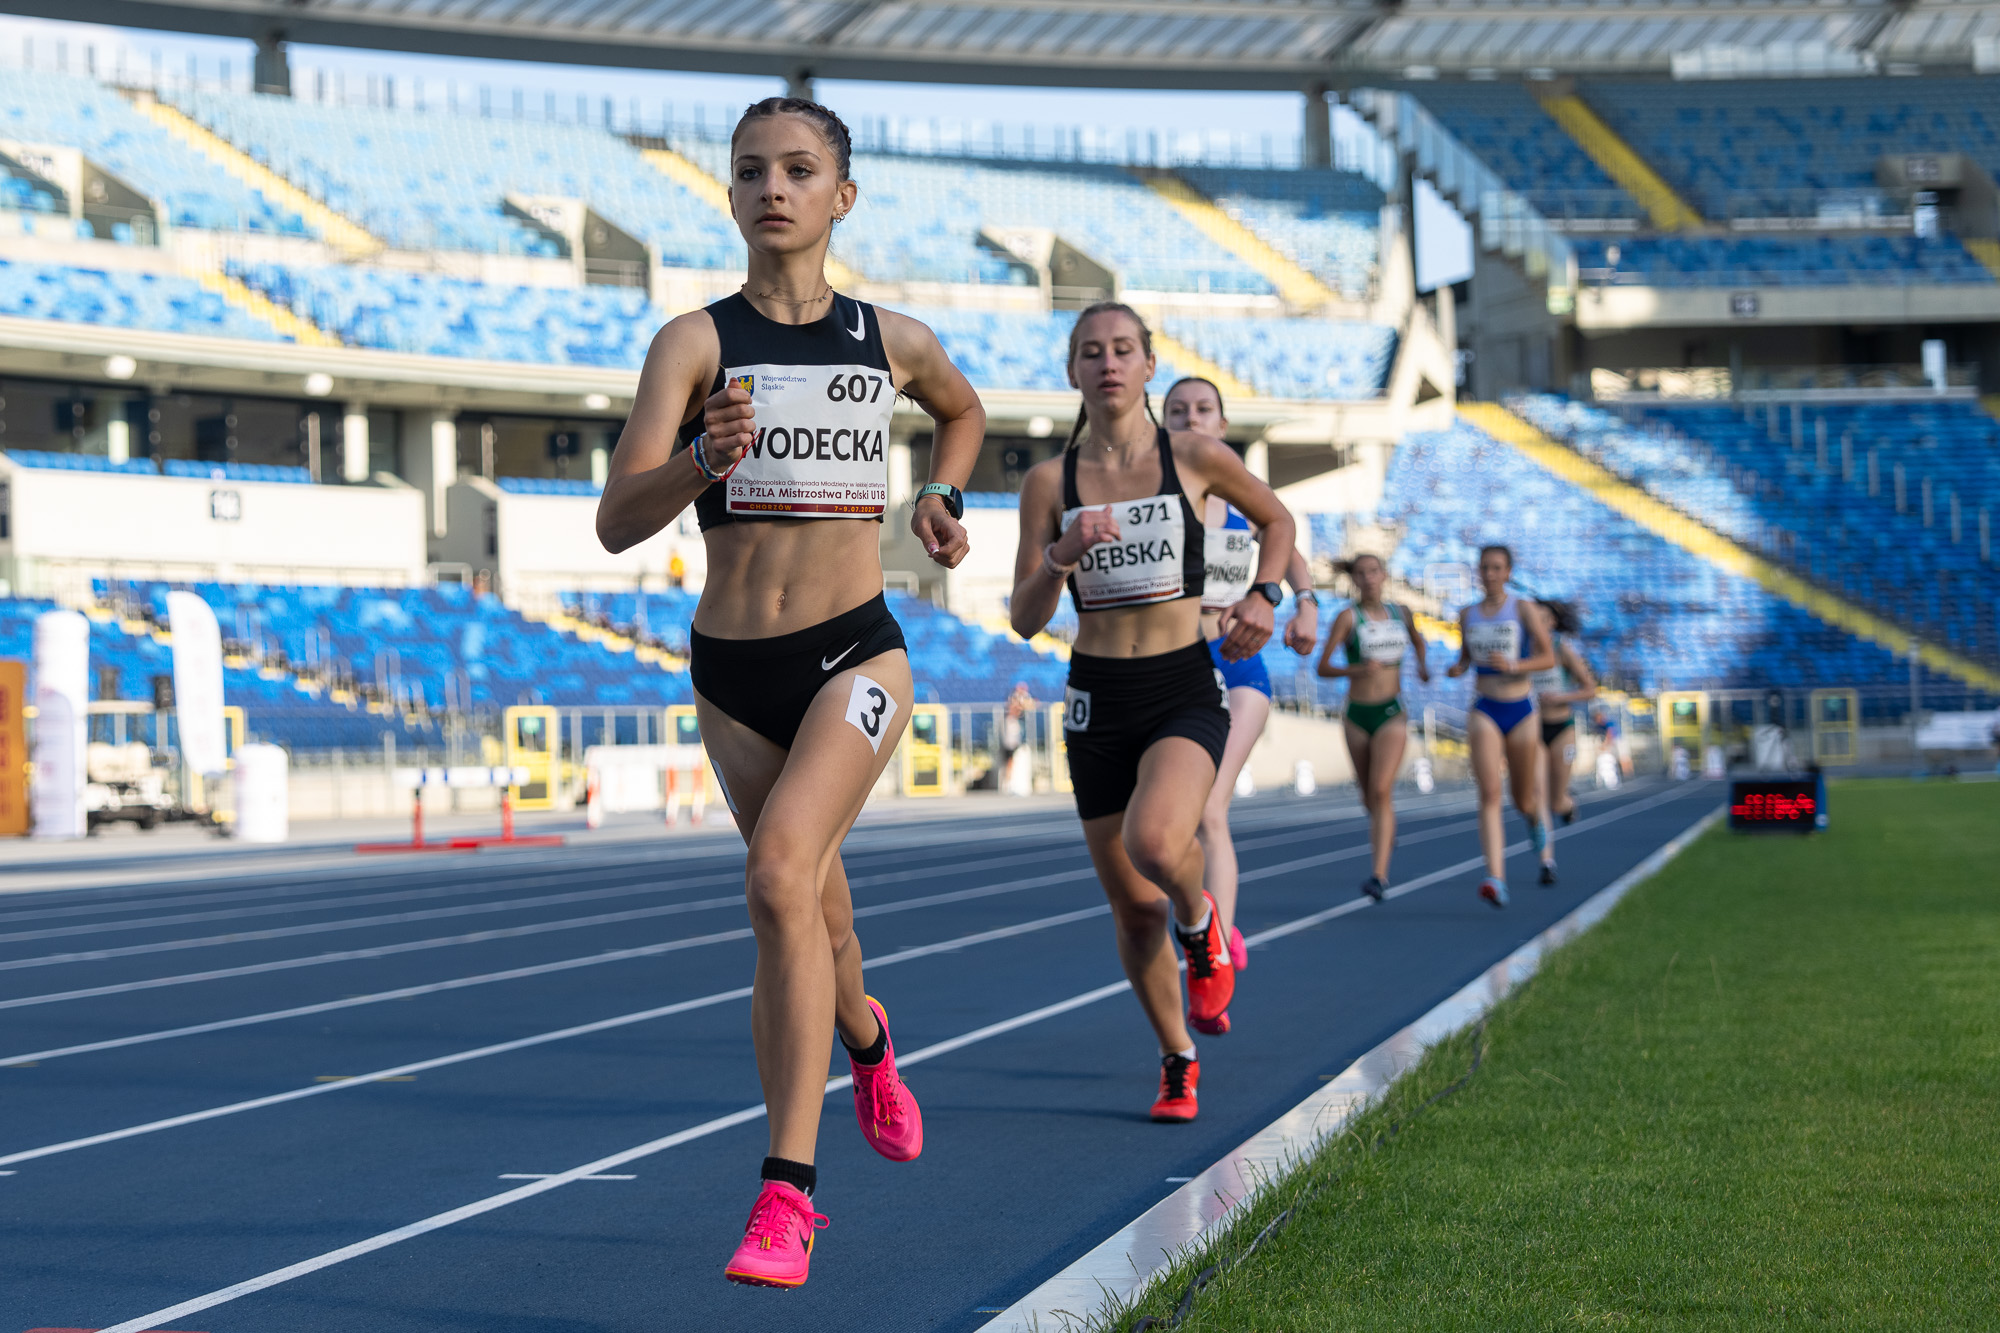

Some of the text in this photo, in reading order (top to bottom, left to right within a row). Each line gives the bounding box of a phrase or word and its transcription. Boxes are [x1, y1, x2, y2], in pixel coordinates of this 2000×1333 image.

[761, 375, 807, 383] Województwo
[761, 383, 785, 392] Śląskie
[827, 374, 883, 404] 607
[731, 486, 886, 500] 55. PZLA Mistrzostwa Polski U18
[750, 503, 792, 511] CHORZÓW
[1128, 502, 1171, 526] 371
[1080, 539, 1175, 574] DĘBSKA
[860, 686, 887, 738] 3
